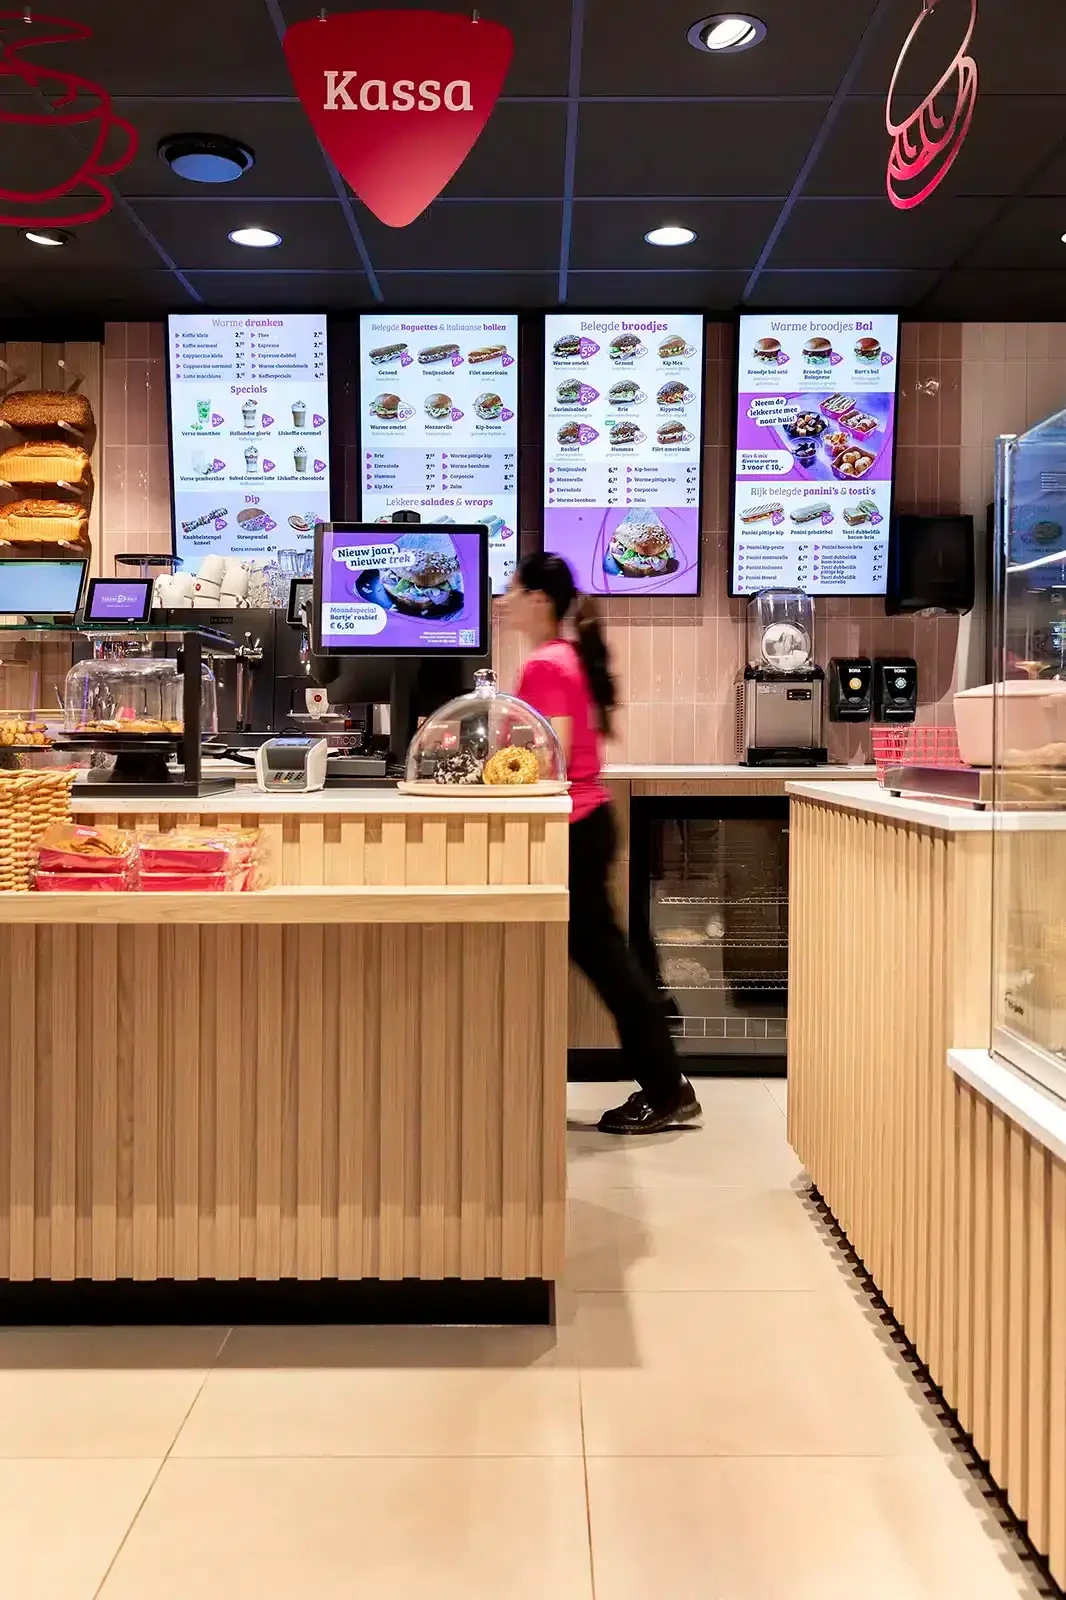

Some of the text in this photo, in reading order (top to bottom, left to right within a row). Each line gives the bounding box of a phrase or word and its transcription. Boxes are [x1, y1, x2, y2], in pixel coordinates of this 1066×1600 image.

[323, 71, 473, 112] Kassa
[212, 319, 283, 327] Warme dranken
[401, 324, 437, 332] Baguettes
[581, 322, 668, 332] Belegde broodjes
[771, 322, 873, 333] Warme broodjes Bal
[231, 385, 267, 395] Specials
[750, 409, 783, 417] lekkerste
[751, 488, 767, 496] Rijk
[770, 488, 801, 497] belegde
[804, 487, 838, 497] panini's
[849, 487, 876, 495] tosti's
[245, 495, 260, 504] Dip
[386, 498, 418, 506] Lekkere
[421, 498, 454, 506] salades
[465, 499, 493, 507] wraps
[338, 547, 395, 558] Nieuw jaar,
[351, 556, 410, 567] nieuwe trek
